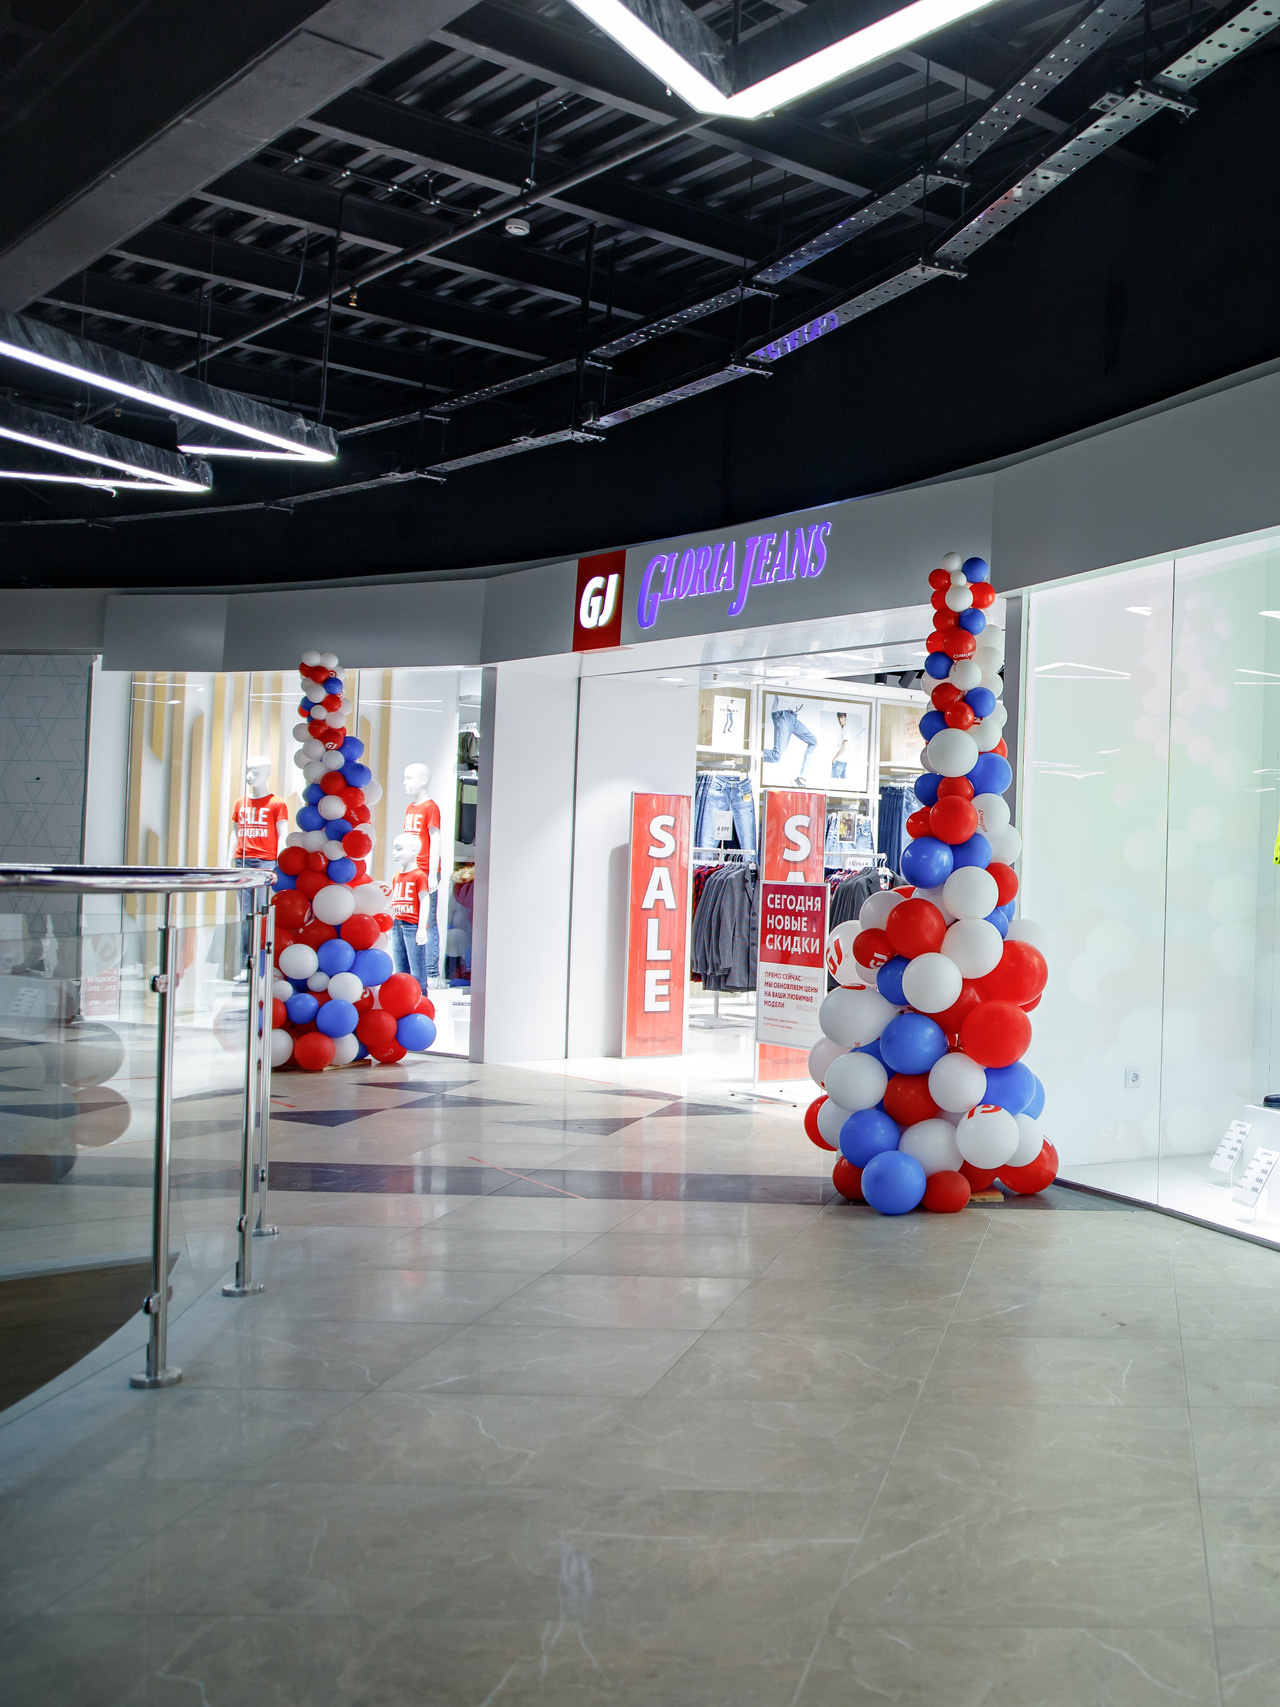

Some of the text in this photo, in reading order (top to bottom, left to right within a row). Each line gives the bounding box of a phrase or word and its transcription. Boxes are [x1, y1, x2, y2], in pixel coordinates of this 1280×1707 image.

[637, 521, 832, 629] GLORIA JEANS
[579, 573, 619, 629] GJ
[239, 806, 269, 825] SALE
[767, 893, 822, 912] СЕГОДНЯ
[641, 814, 677, 1014] SALE
[766, 914, 808, 932] НОВЫЕ
[765, 934, 820, 955] СКИДКИ
[764, 971, 802, 982] ПРЯМО СЕЙЧАС
[773, 982, 804, 992] ОБНОВЛЯЕМ
[804, 986, 819, 994] ЦЕНЫ
[763, 1000, 785, 1009] МОДЕЛИ
